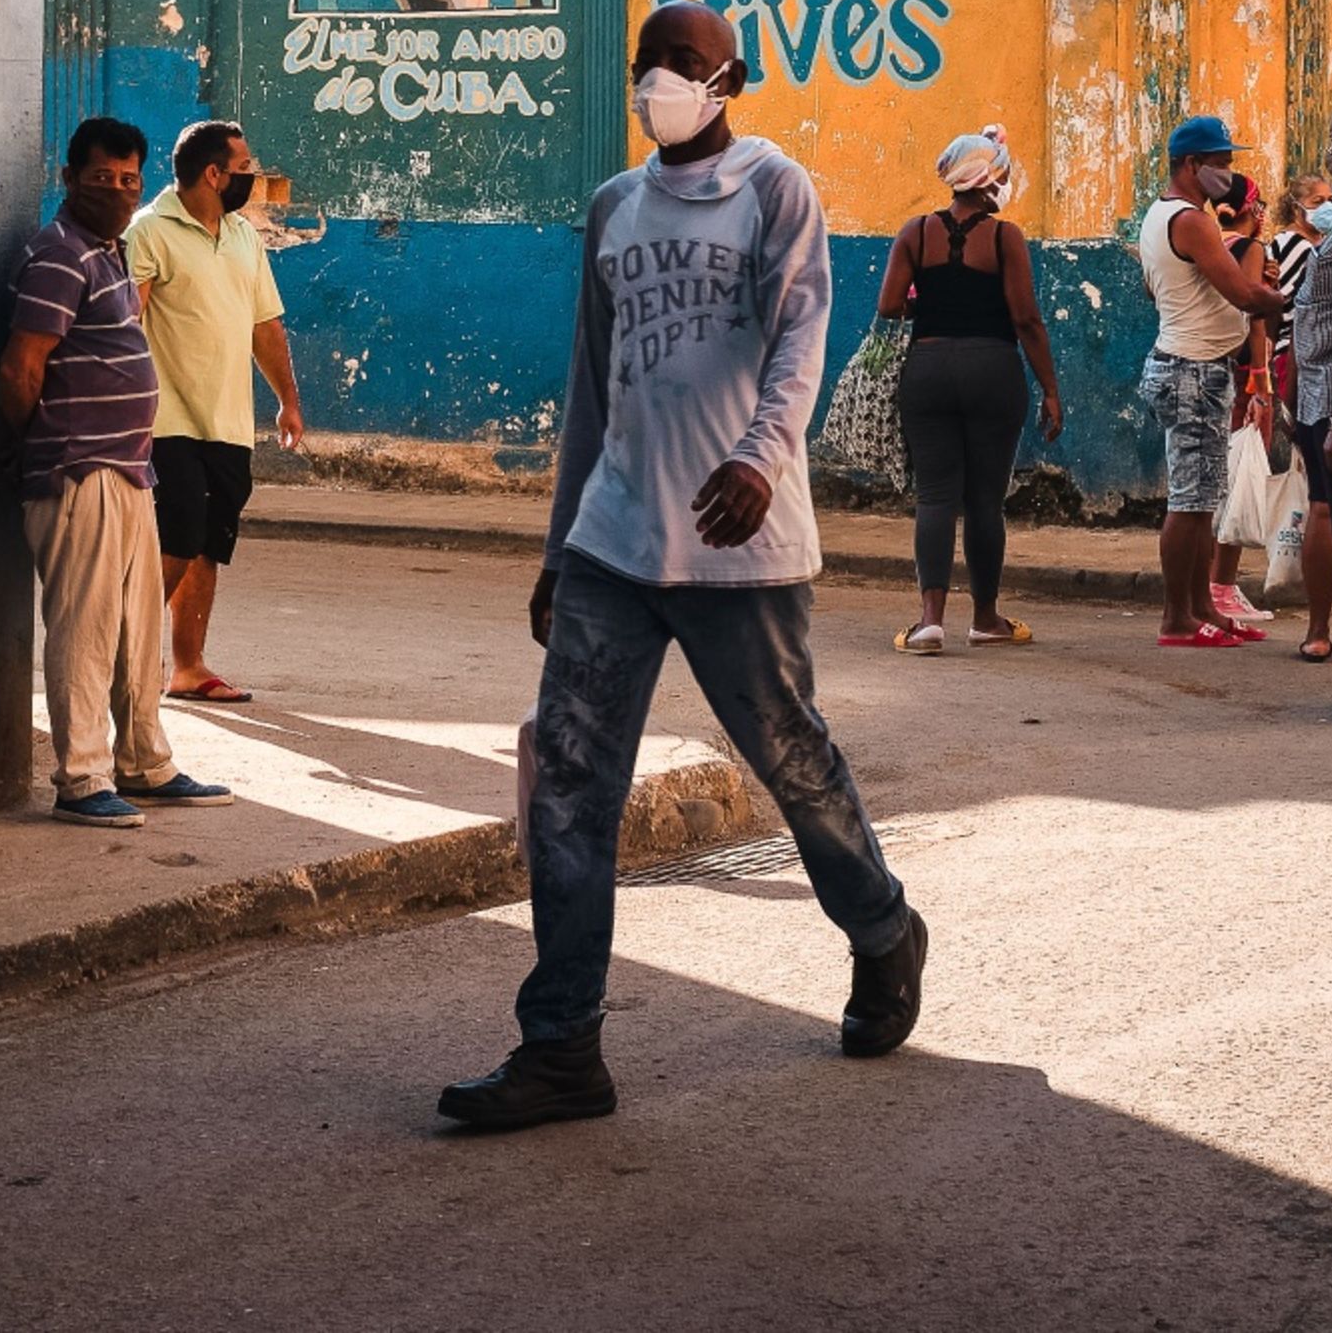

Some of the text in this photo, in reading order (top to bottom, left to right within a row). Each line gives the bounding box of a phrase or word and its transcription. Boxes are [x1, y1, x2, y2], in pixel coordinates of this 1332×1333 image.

[282, 17, 336, 74] El
[451, 25, 567, 61] AMIGO
[314, 65, 375, 115] de
[599, 238, 760, 283] POWER
[616, 277, 744, 341] DENIM
[640, 313, 713, 373] DPT
